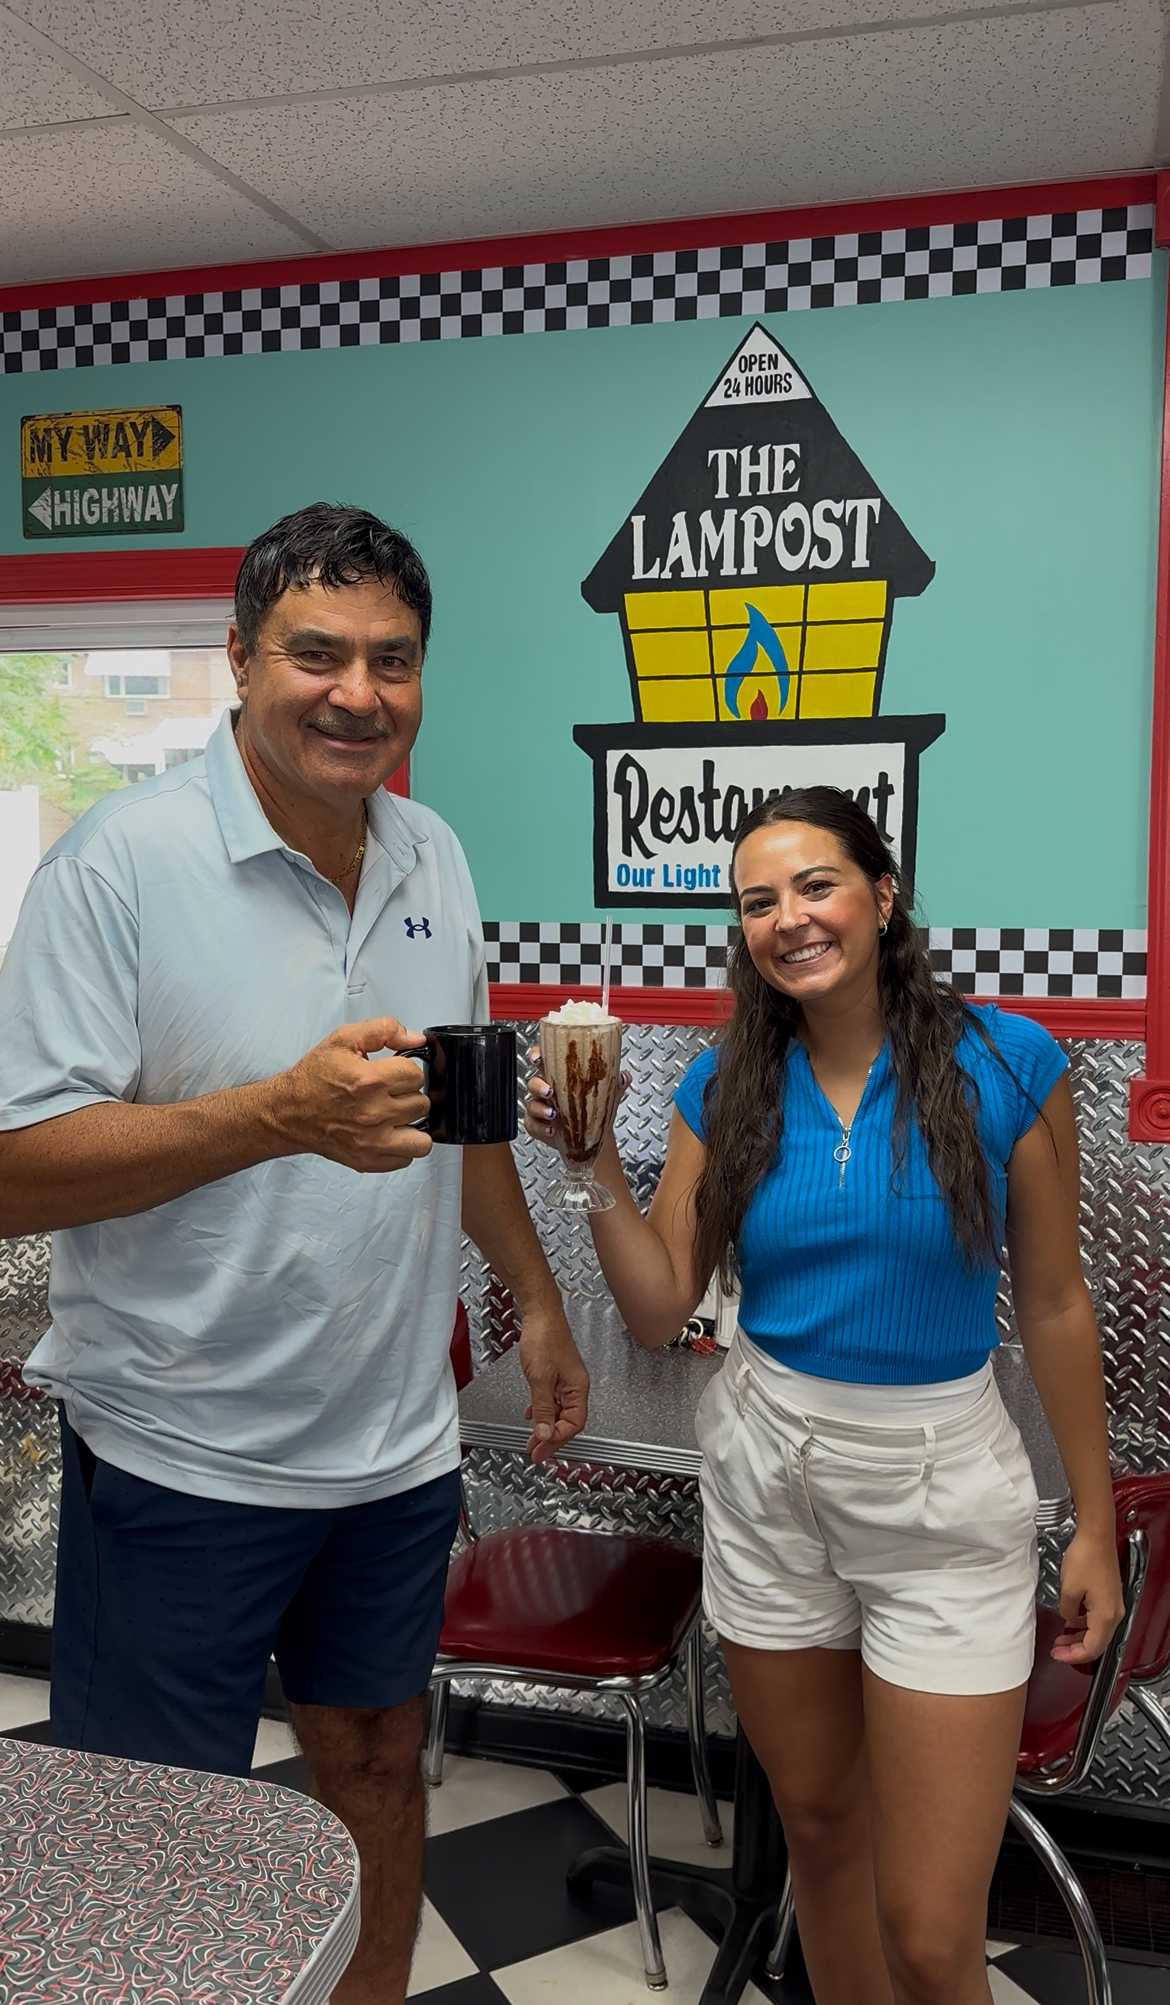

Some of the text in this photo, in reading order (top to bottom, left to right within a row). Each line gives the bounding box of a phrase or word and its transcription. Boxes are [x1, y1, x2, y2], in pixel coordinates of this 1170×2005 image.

[738, 353, 779, 373] OPEN
[723, 373, 793, 399] 24 HOURS
[30, 419, 151, 464] MY WAY
[707, 443, 801, 499] THE
[54, 483, 178, 526] HIGHWAY
[631, 498, 881, 580] LAMPOST
[616, 863, 655, 887] Our
[662, 863, 721, 891] Light
